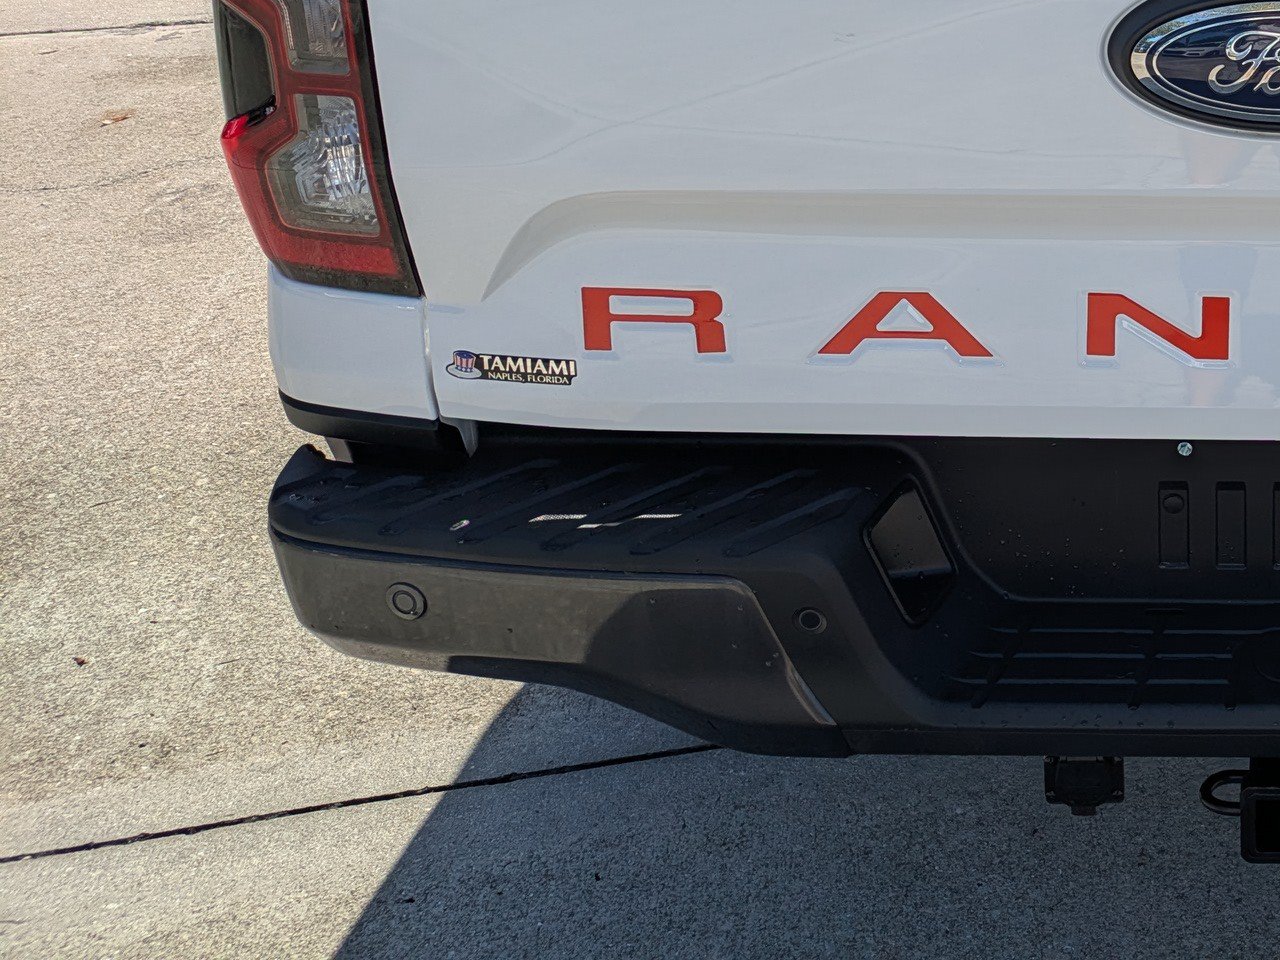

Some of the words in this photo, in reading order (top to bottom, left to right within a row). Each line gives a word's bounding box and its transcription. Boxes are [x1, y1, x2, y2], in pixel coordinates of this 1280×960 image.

[479, 354, 577, 376] TAMIAMI
[487, 371, 526, 383] NAPLES,
[527, 373, 570, 385] FLORIDA
